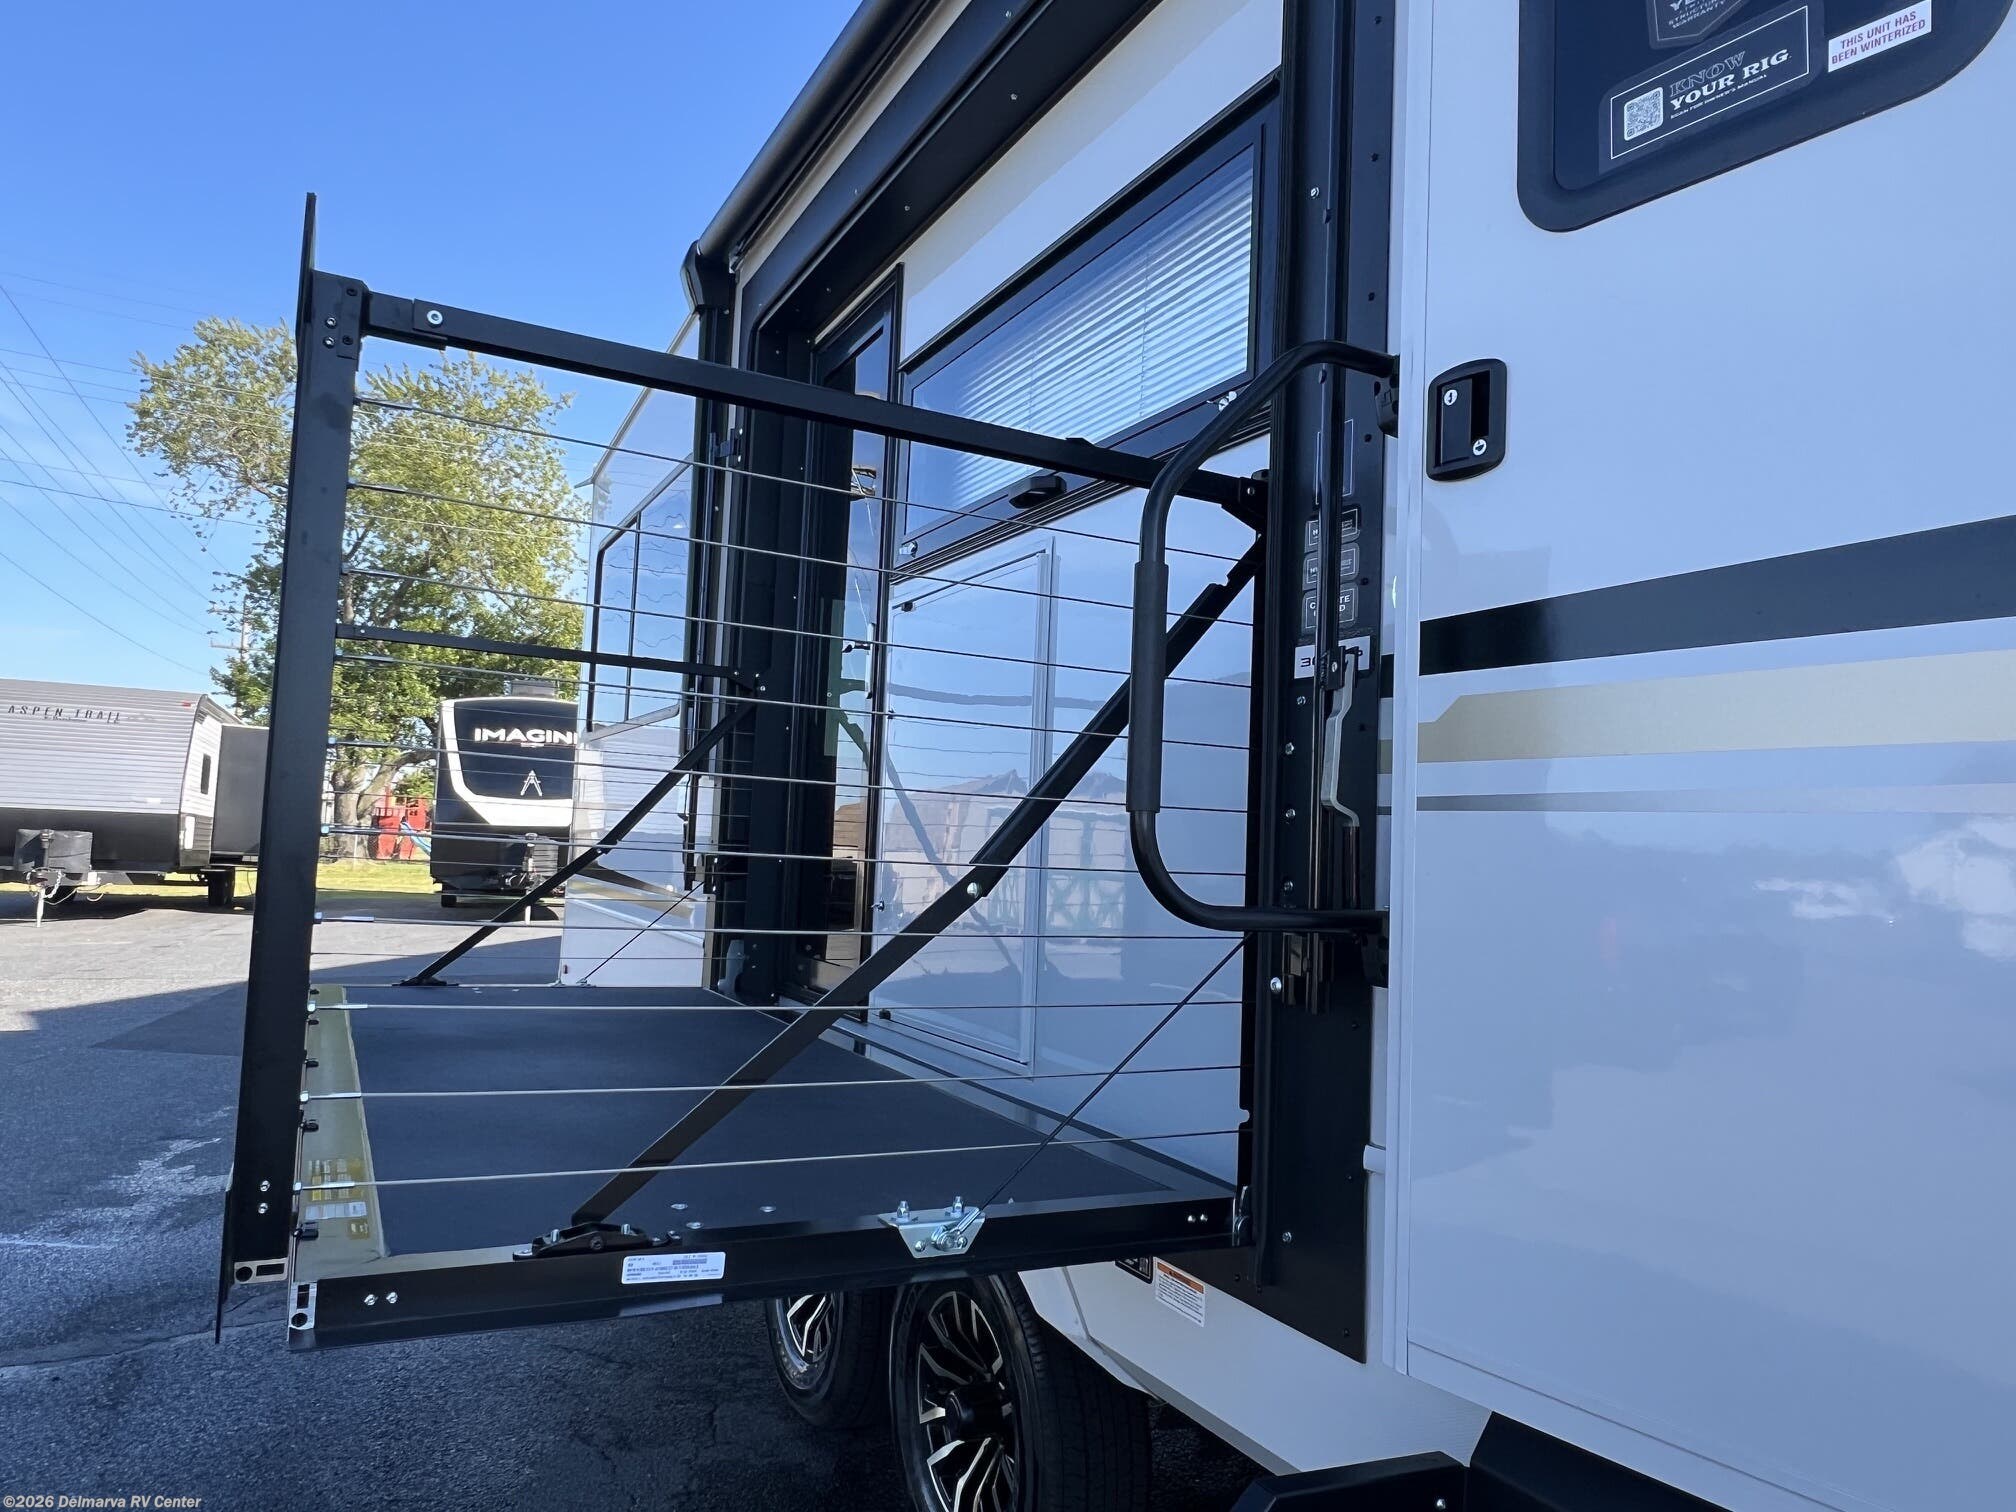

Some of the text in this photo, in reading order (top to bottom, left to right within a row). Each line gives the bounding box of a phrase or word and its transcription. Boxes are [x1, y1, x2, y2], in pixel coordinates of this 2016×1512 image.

[1831, 19, 1926, 64] BEEN WINTERIZED
[1840, 11, 1917, 50] THIS UNIT HAS
[1670, 51, 1746, 97] KNOW
[1670, 49, 1789, 111] YOUR RIG
[7, 704, 63, 717] ASPEN
[75, 708, 120, 724] TRAIL
